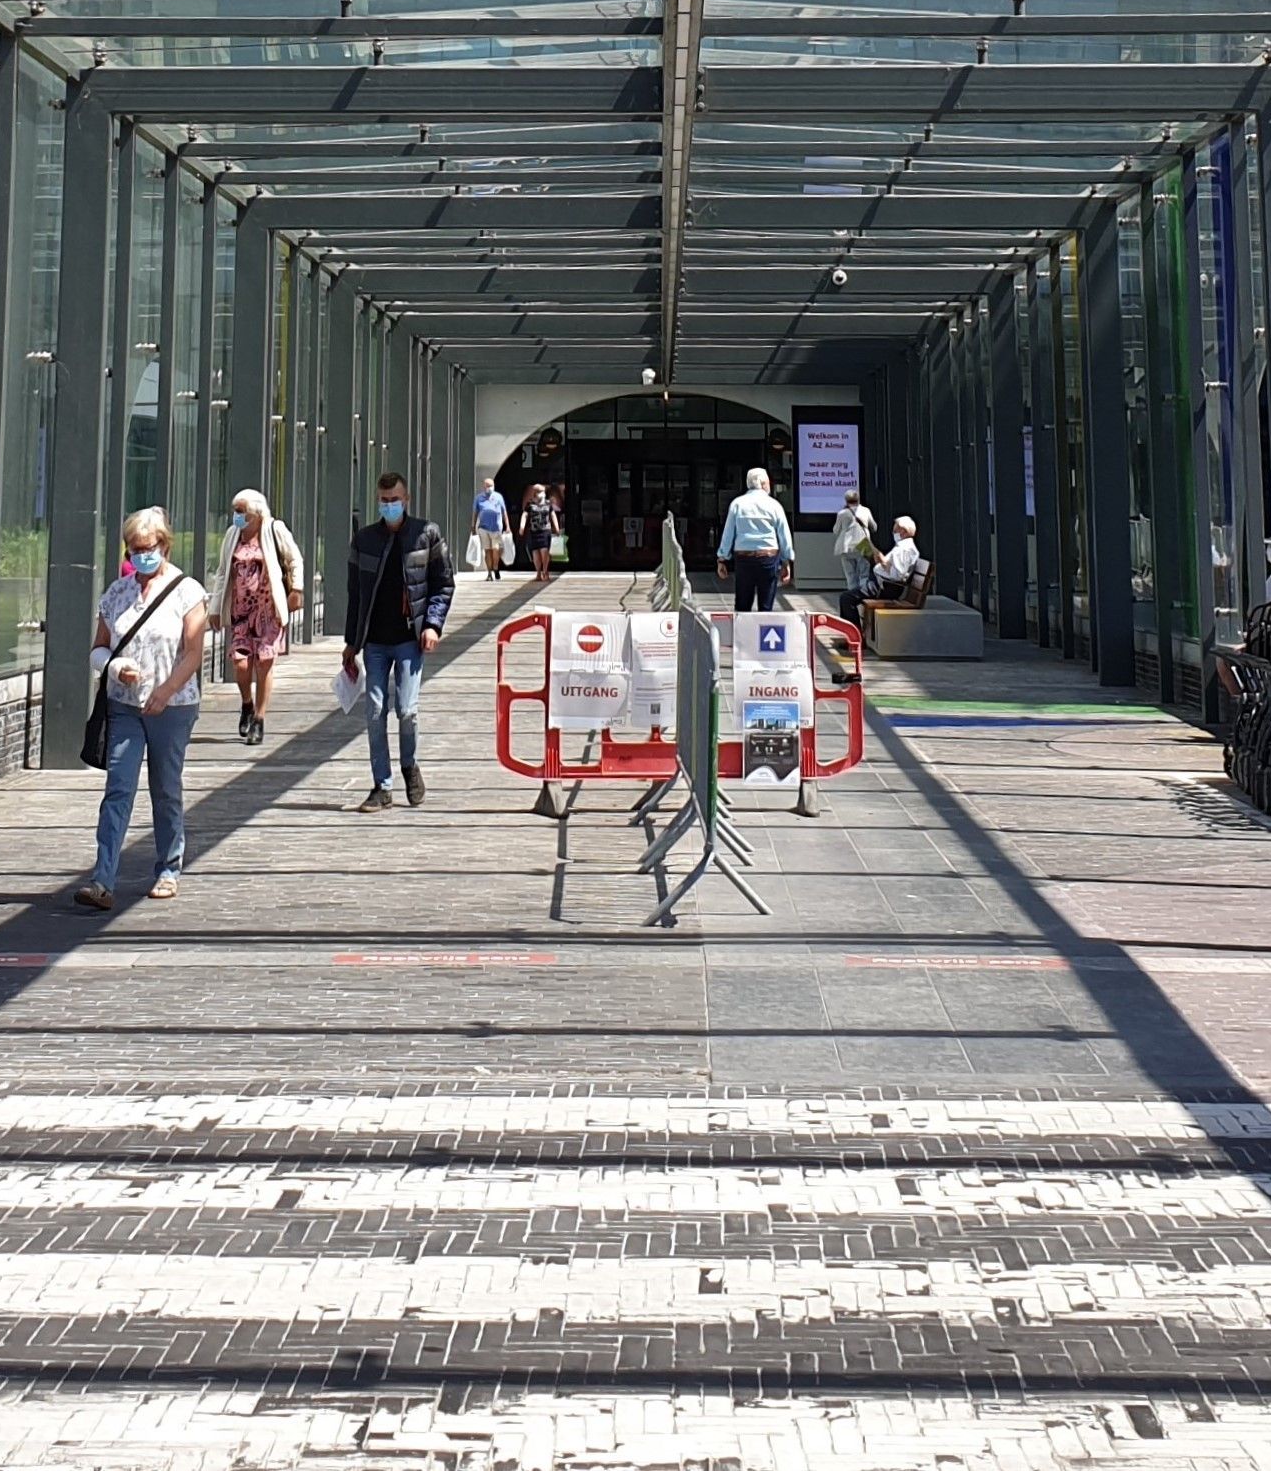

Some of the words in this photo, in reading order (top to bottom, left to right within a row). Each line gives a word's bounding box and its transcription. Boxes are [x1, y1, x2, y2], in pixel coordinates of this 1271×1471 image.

[808, 432, 839, 440] Welkom
[841, 432, 849, 440] in
[831, 462, 848, 470] zorg
[801, 479, 833, 487] centraal
[835, 479, 857, 487] staat!
[561, 686, 618, 697] UITGANG
[749, 686, 799, 697] INGANG
